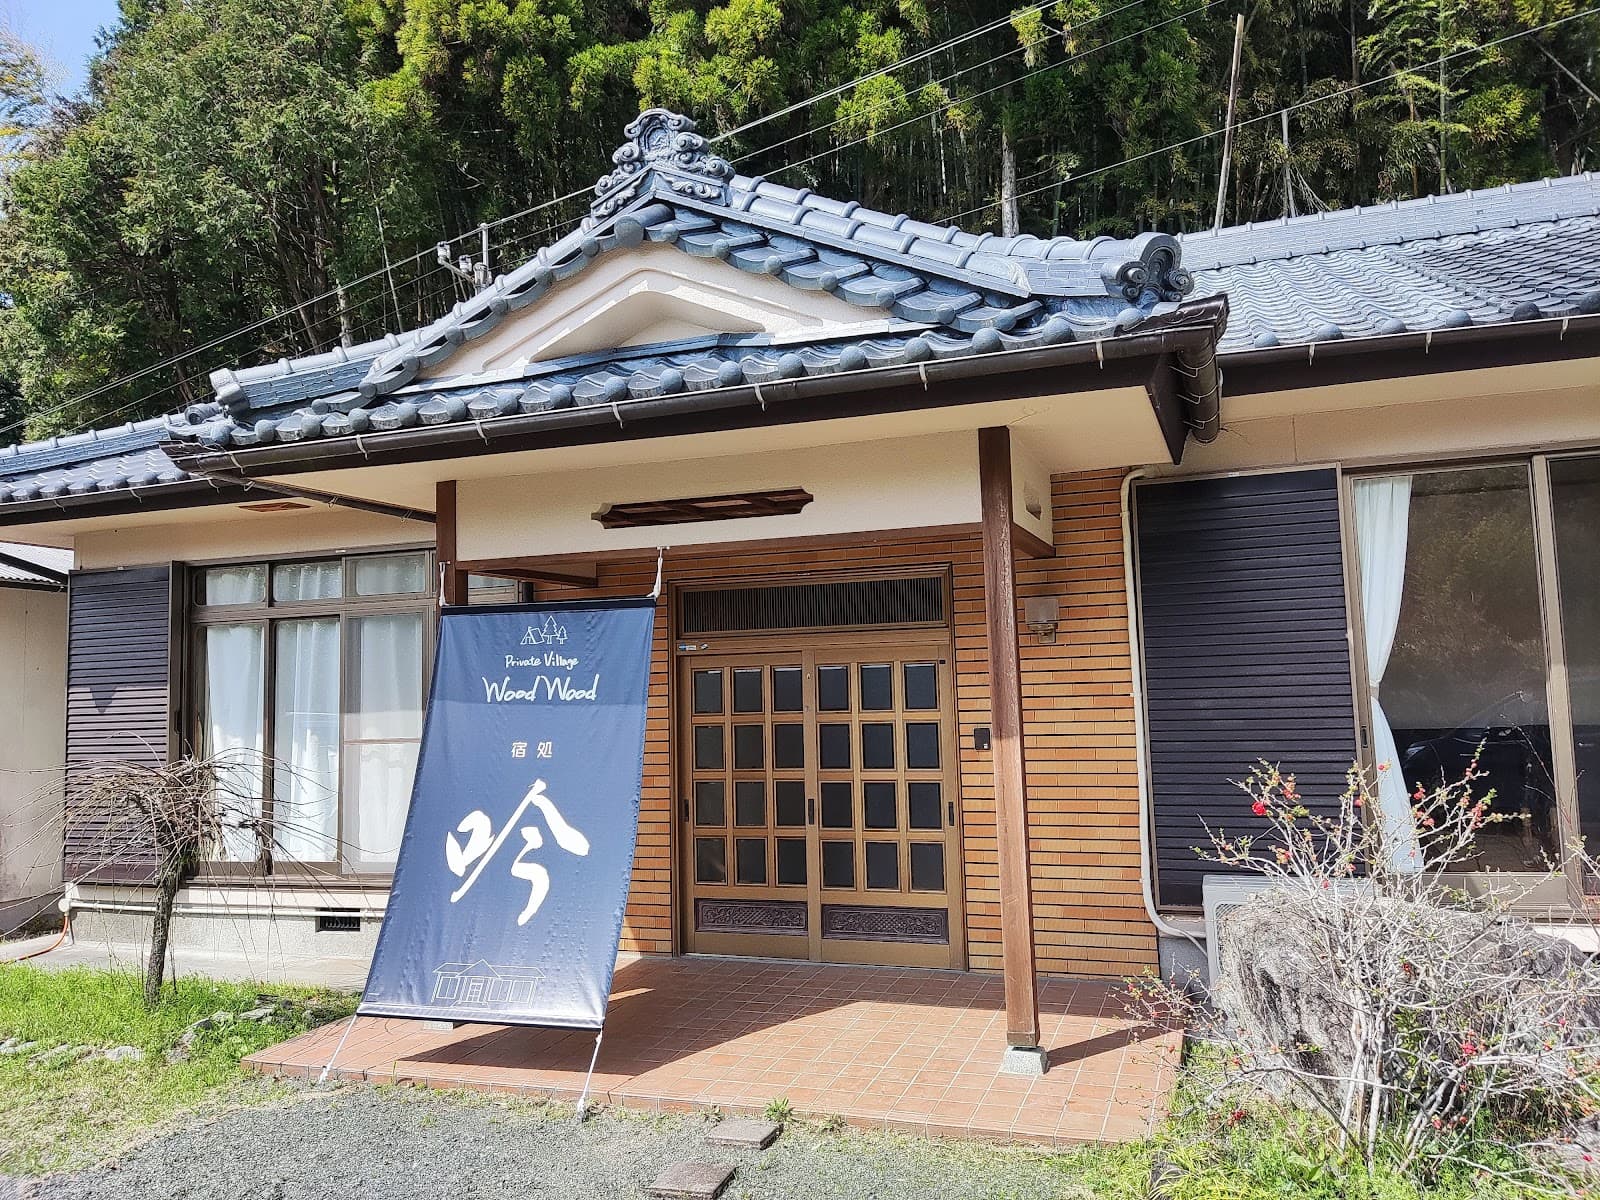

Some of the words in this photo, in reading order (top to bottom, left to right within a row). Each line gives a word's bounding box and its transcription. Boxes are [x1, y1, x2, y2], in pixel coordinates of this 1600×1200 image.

[505, 655, 542, 668] Private
[544, 651, 579, 671] Village
[482, 675, 541, 703] Wood
[541, 674, 600, 701] Wood
[446, 778, 590, 926] 吟
